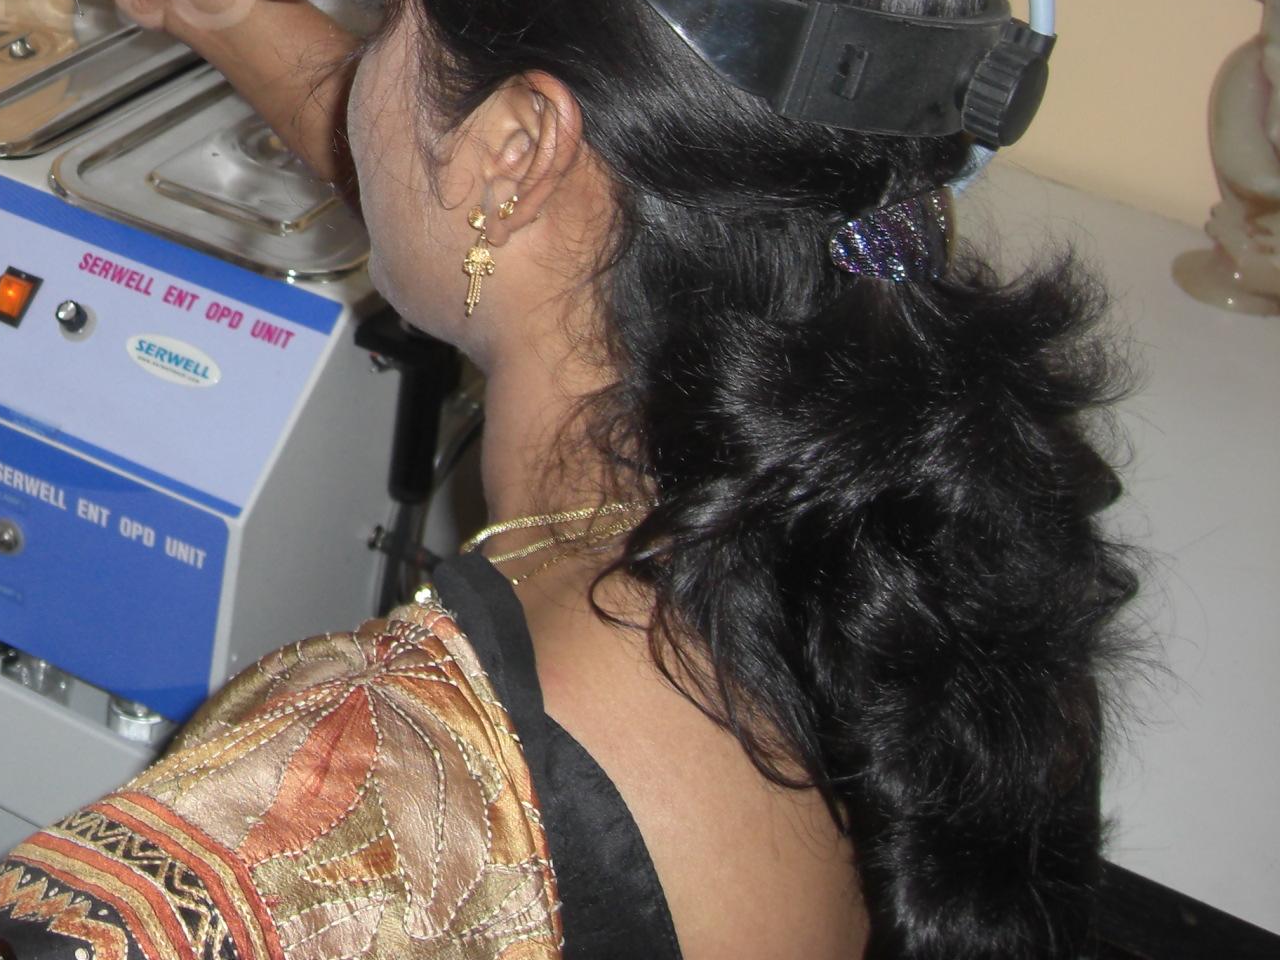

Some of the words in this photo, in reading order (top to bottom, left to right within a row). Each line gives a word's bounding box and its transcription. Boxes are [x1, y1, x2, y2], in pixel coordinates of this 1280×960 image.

[78, 252, 155, 296] SERWELL
[162, 284, 200, 312] ENT
[205, 301, 244, 330] OPD
[250, 318, 296, 350] UNIT
[135, 338, 210, 380] SERWELL
[76, 497, 112, 528] ENT
[119, 516, 156, 548] OPD
[164, 536, 207, 570] UNIT
